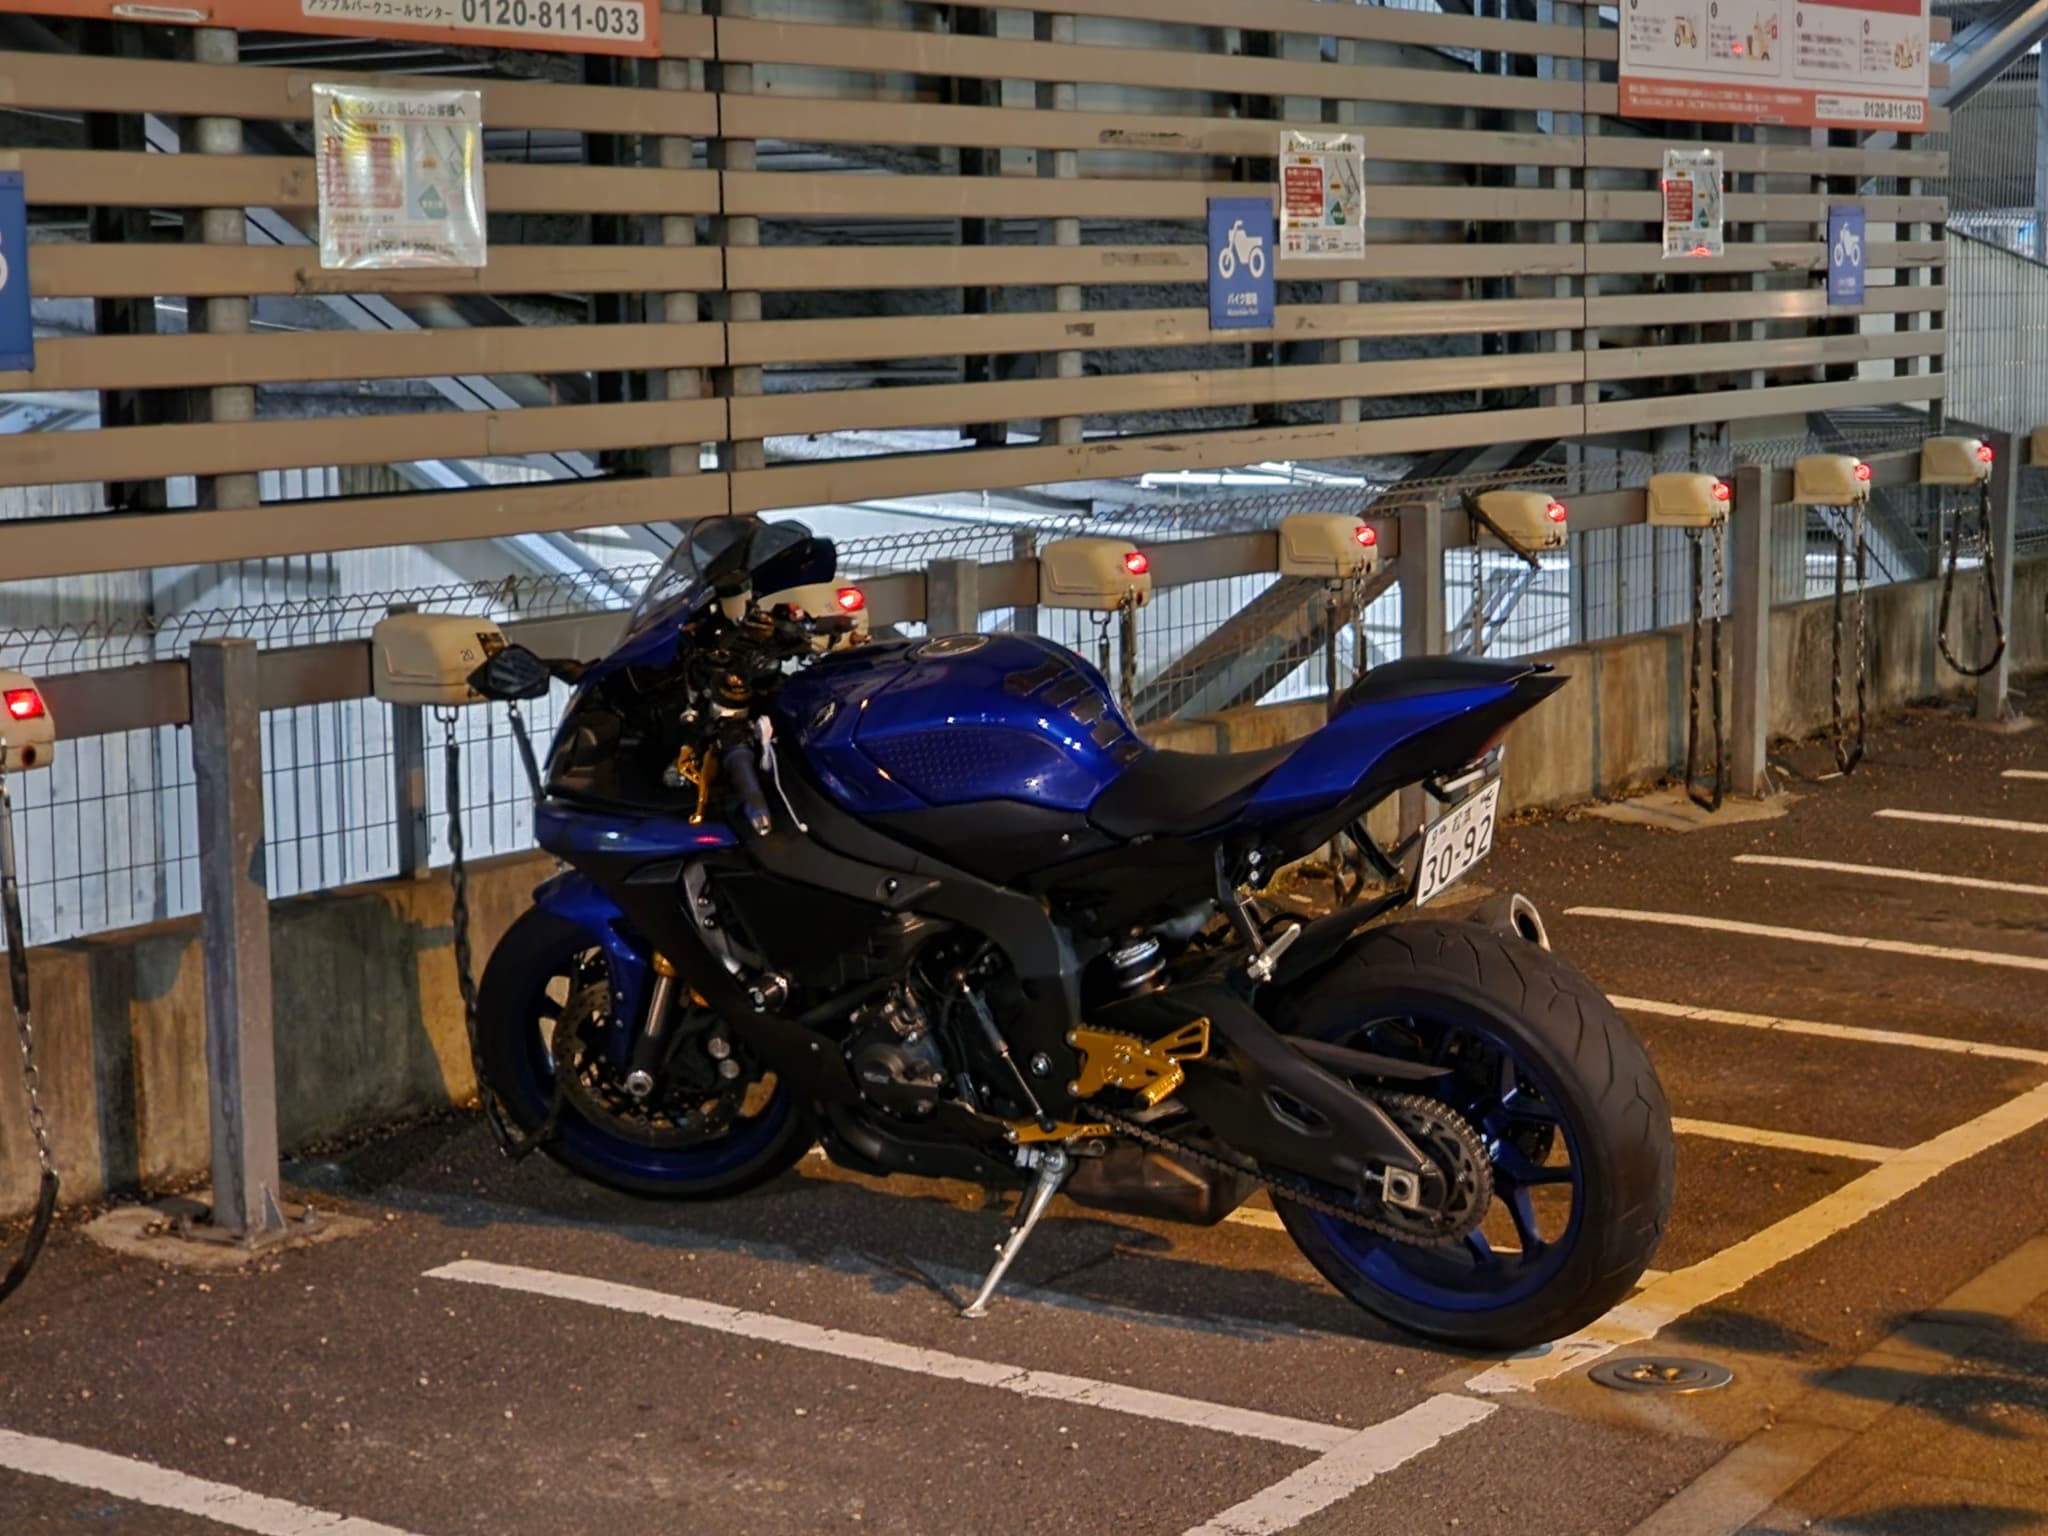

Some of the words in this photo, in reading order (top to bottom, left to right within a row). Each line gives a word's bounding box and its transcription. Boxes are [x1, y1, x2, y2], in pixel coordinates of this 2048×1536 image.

[462, 0, 640, 35] 0120-811-033
[1864, 101, 1921, 120] 0120-811-033
[1422, 814, 1491, 897] 30-92
